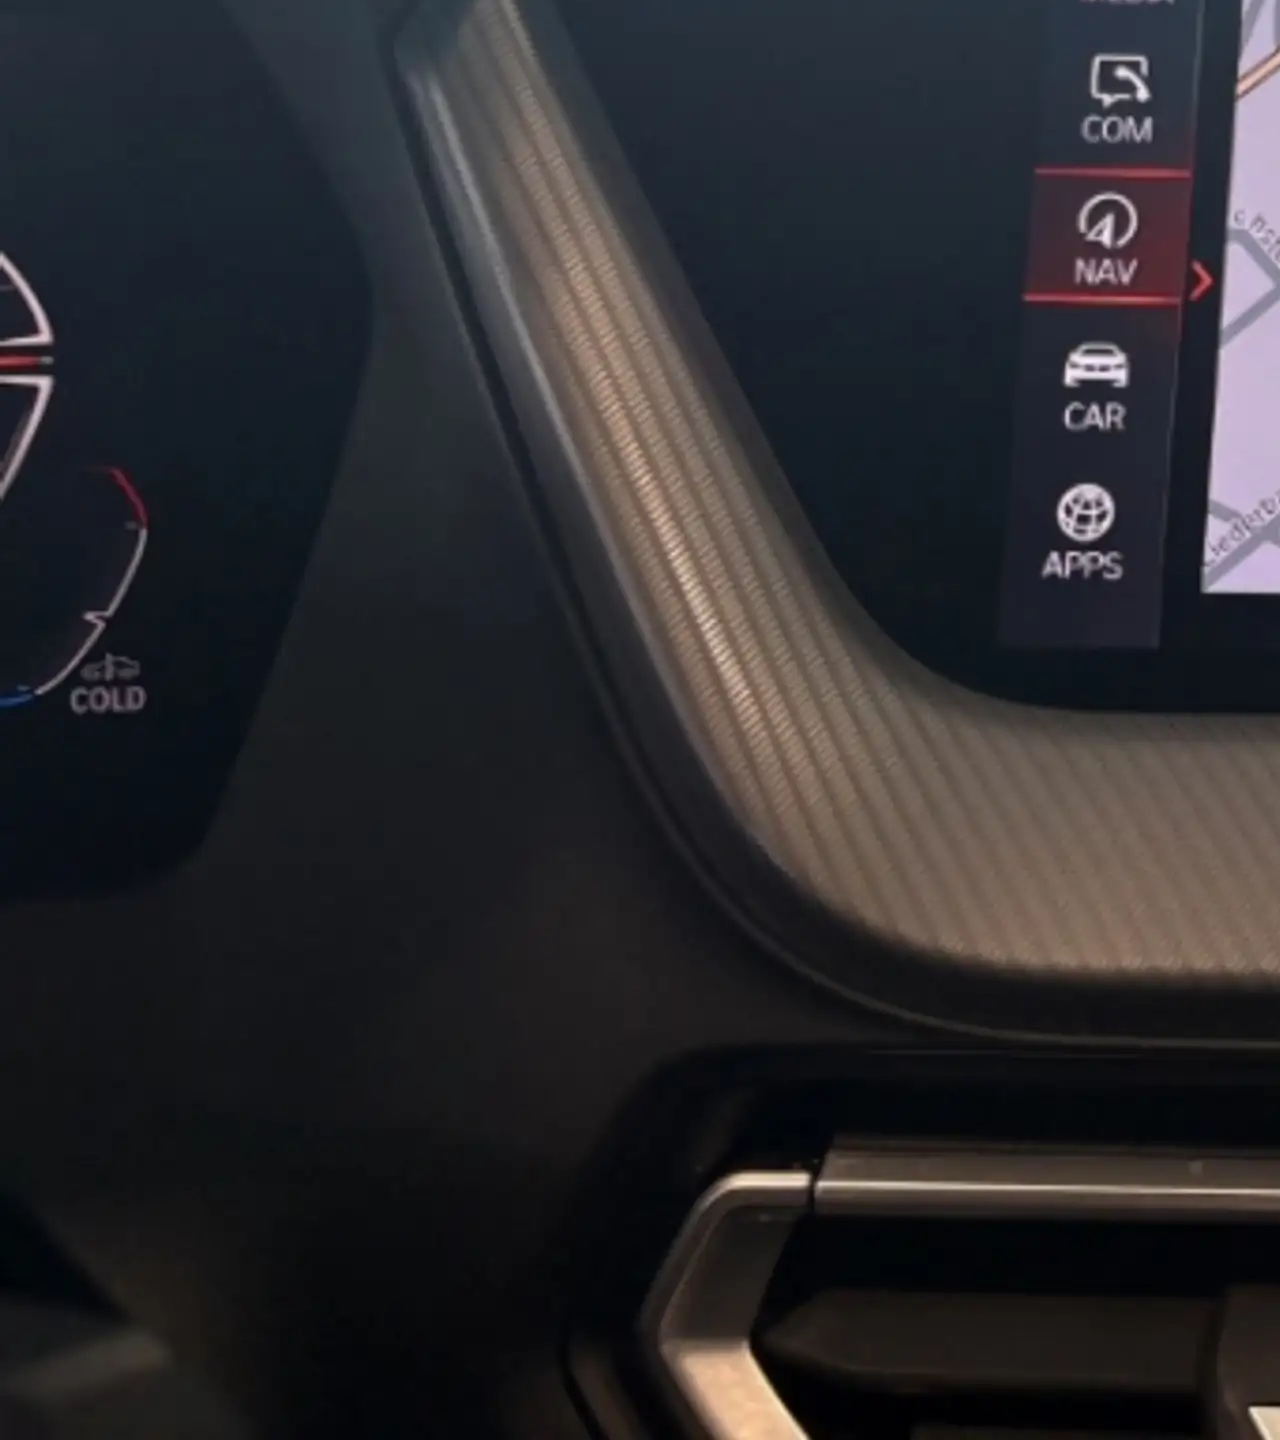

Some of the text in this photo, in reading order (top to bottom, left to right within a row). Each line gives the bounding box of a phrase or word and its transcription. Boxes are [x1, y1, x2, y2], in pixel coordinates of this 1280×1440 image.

[1080, 114, 1155, 145] COM
[1073, 257, 1139, 287] NAV
[1062, 401, 1127, 432] CAR
[1041, 549, 1124, 581] APPS
[69, 685, 147, 715] COLD
